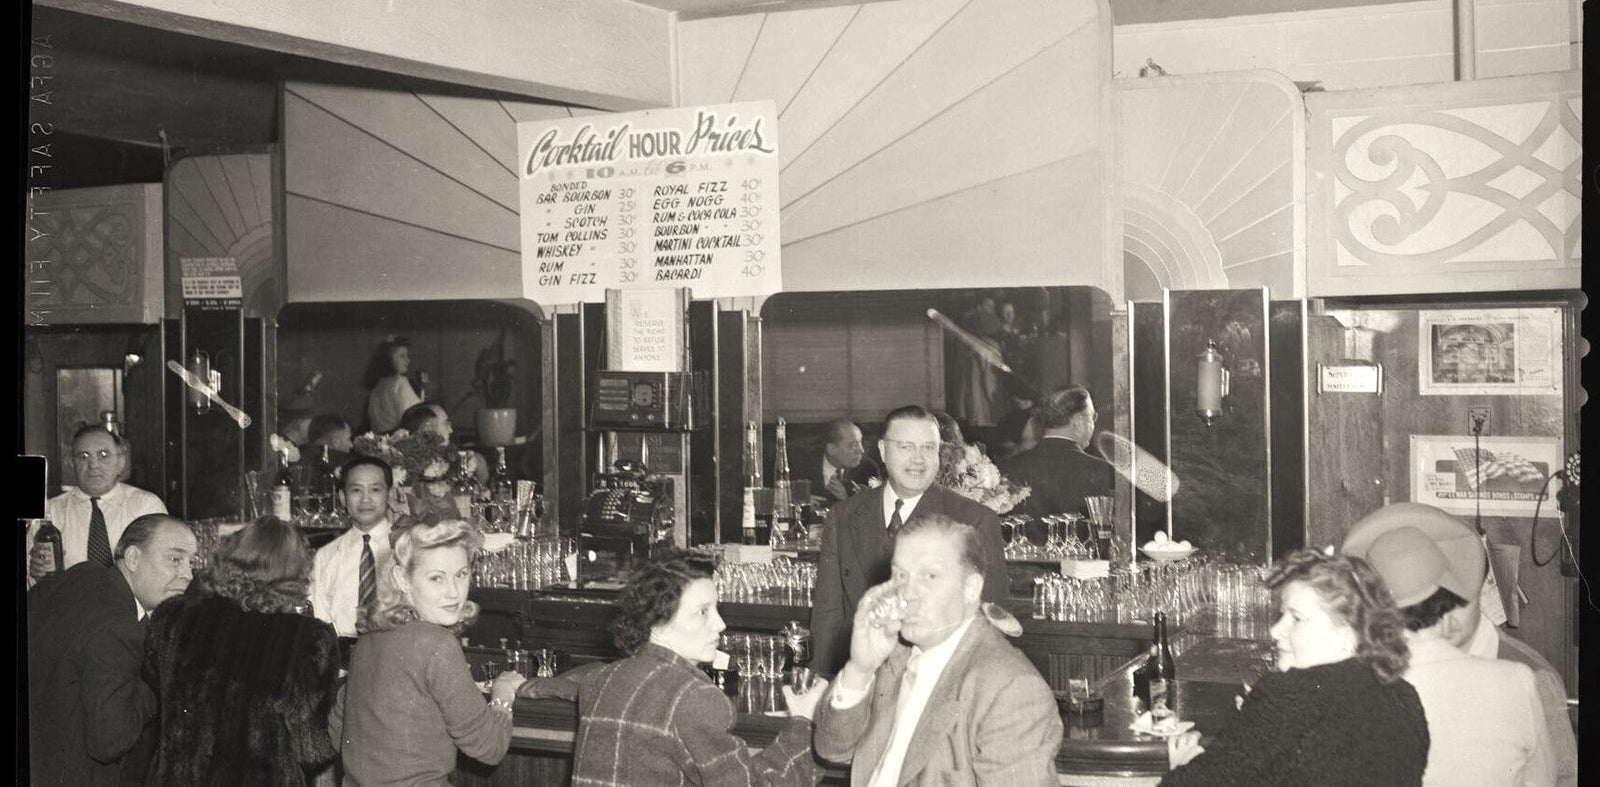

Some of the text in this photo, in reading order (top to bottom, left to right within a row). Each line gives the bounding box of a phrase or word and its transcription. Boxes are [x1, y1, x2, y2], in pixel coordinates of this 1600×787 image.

[527, 111, 774, 175] Cocktail HOUR Prices
[586, 167, 615, 179] 10
[665, 160, 686, 174] 6
[550, 182, 587, 192] BONDED
[653, 184, 689, 196] ROYAL
[697, 181, 728, 193] FIZZ
[536, 192, 558, 205] BAR
[562, 189, 612, 203] BOURBON
[653, 198, 680, 210] EGG
[687, 194, 724, 207] NOGG
[574, 203, 595, 215] GIN
[652, 211, 676, 223] RUM
[687, 209, 712, 221] COCA
[713, 207, 737, 219] COLA
[564, 216, 608, 229] SCOTCH
[654, 223, 700, 237] BOURBON
[537, 232, 559, 243] TOM
[565, 228, 608, 242] COLLINS
[653, 237, 693, 252] MARTINI
[695, 234, 741, 249] COCKTAIL
[536, 243, 583, 258] WHISKEY
[538, 260, 564, 273] RUM
[654, 253, 714, 267] MANHATTAN
[538, 275, 562, 286] GIN
[569, 272, 597, 285] FIZZ
[655, 267, 702, 281] BACARDI
